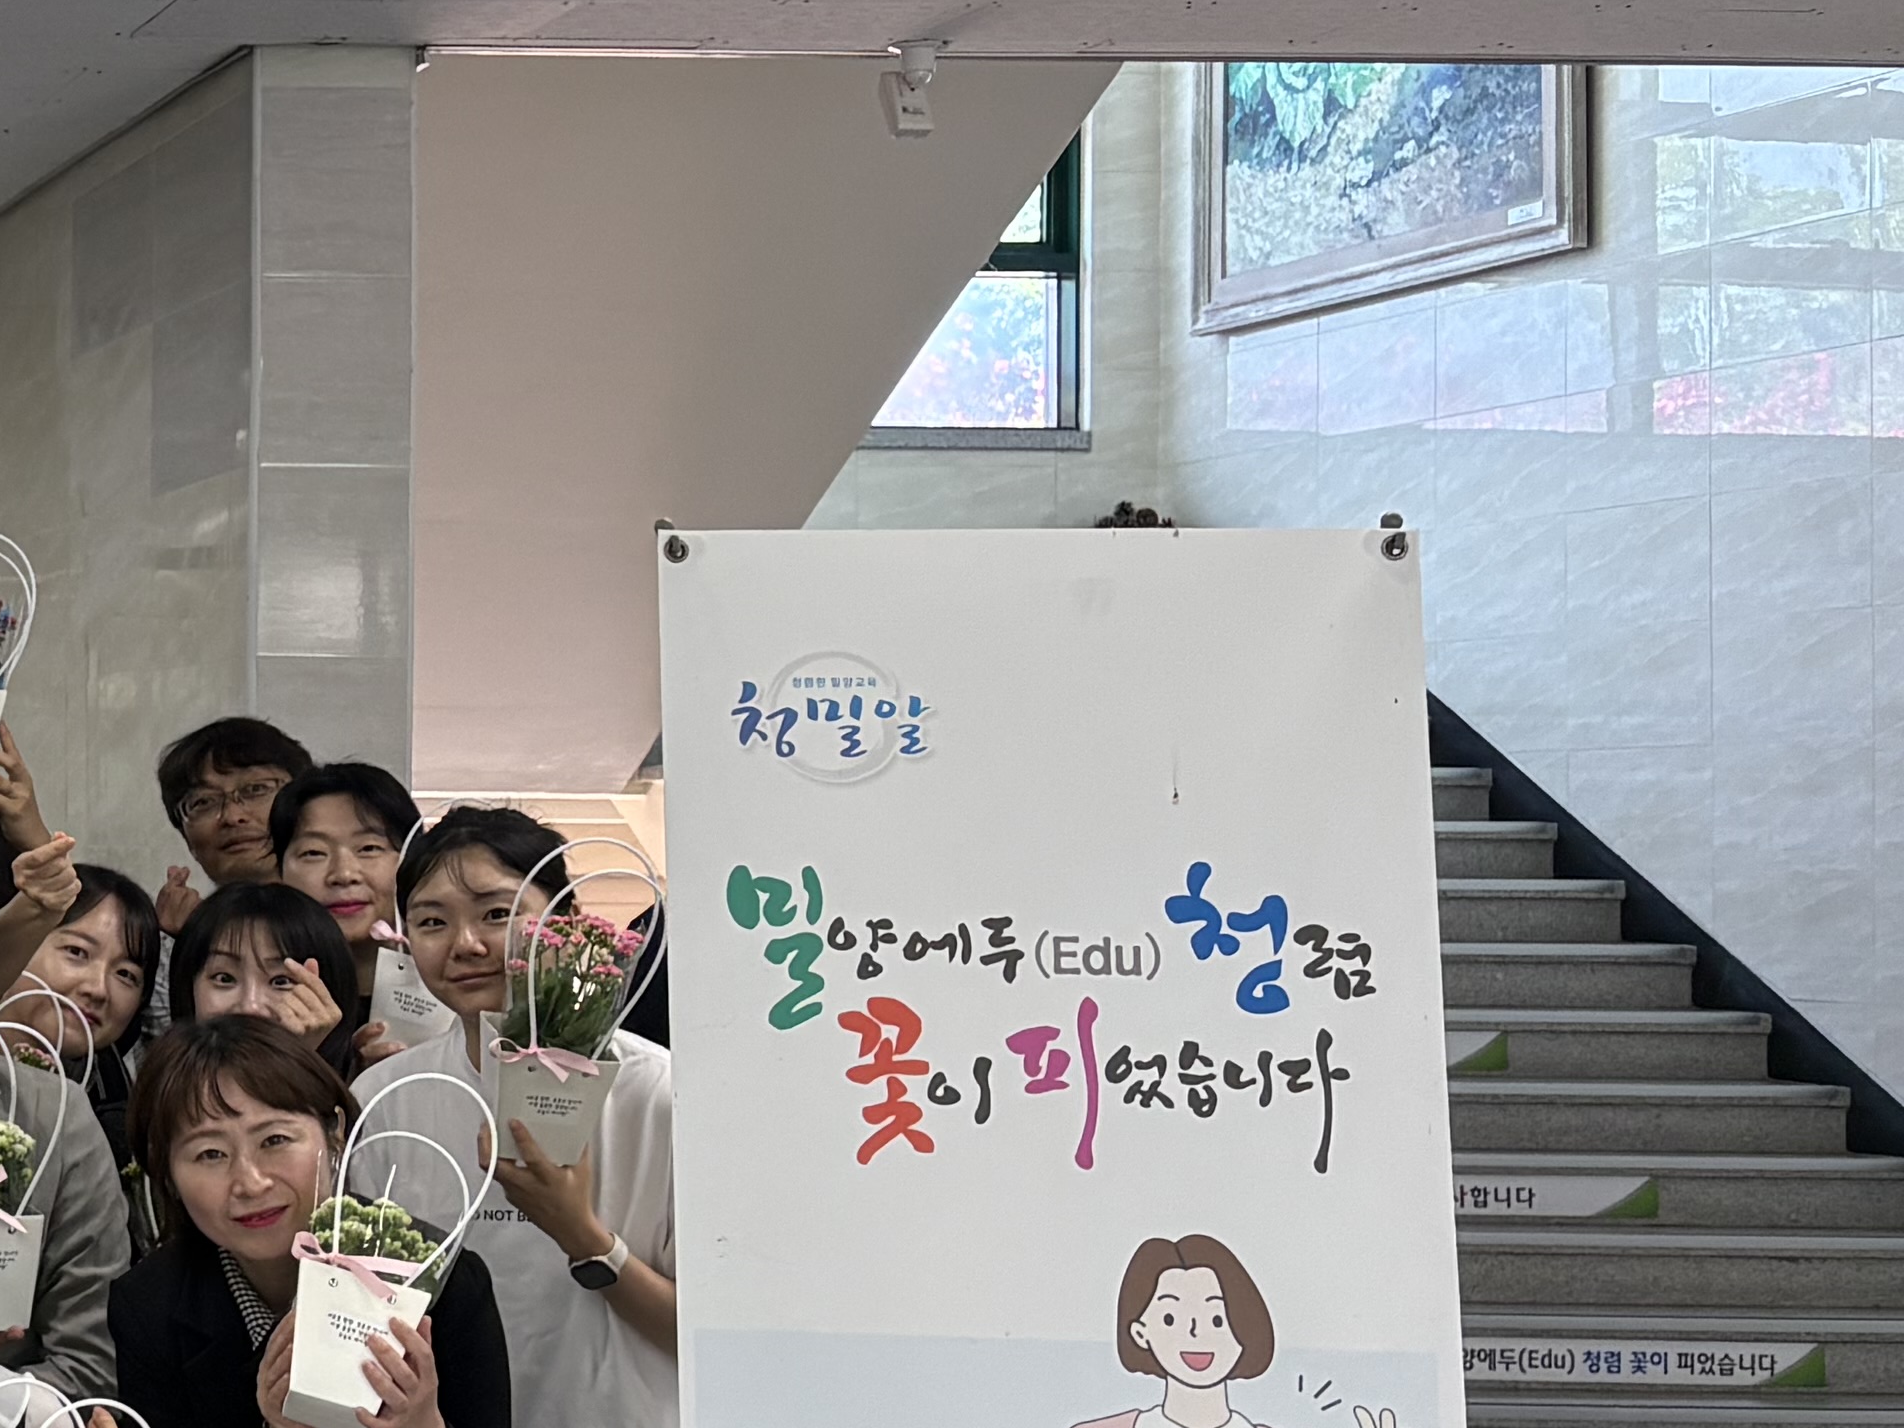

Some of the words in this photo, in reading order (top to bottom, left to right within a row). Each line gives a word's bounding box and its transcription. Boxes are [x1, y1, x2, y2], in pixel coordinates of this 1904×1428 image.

[731, 681, 931, 758] 청밀알
[1164, 861, 1376, 1015] 청렴
[837, 996, 992, 1165] 꽃이
[1005, 996, 1350, 1174] 피었습니다
[484, 1210, 514, 1221] NOT
[1463, 1348, 1575, 1375] 양에두(Edu)
[1582, 1349, 1622, 1374] 청렴
[1629, 1349, 1669, 1375] 꽃이
[1677, 1351, 1777, 1378] 피었습니다
